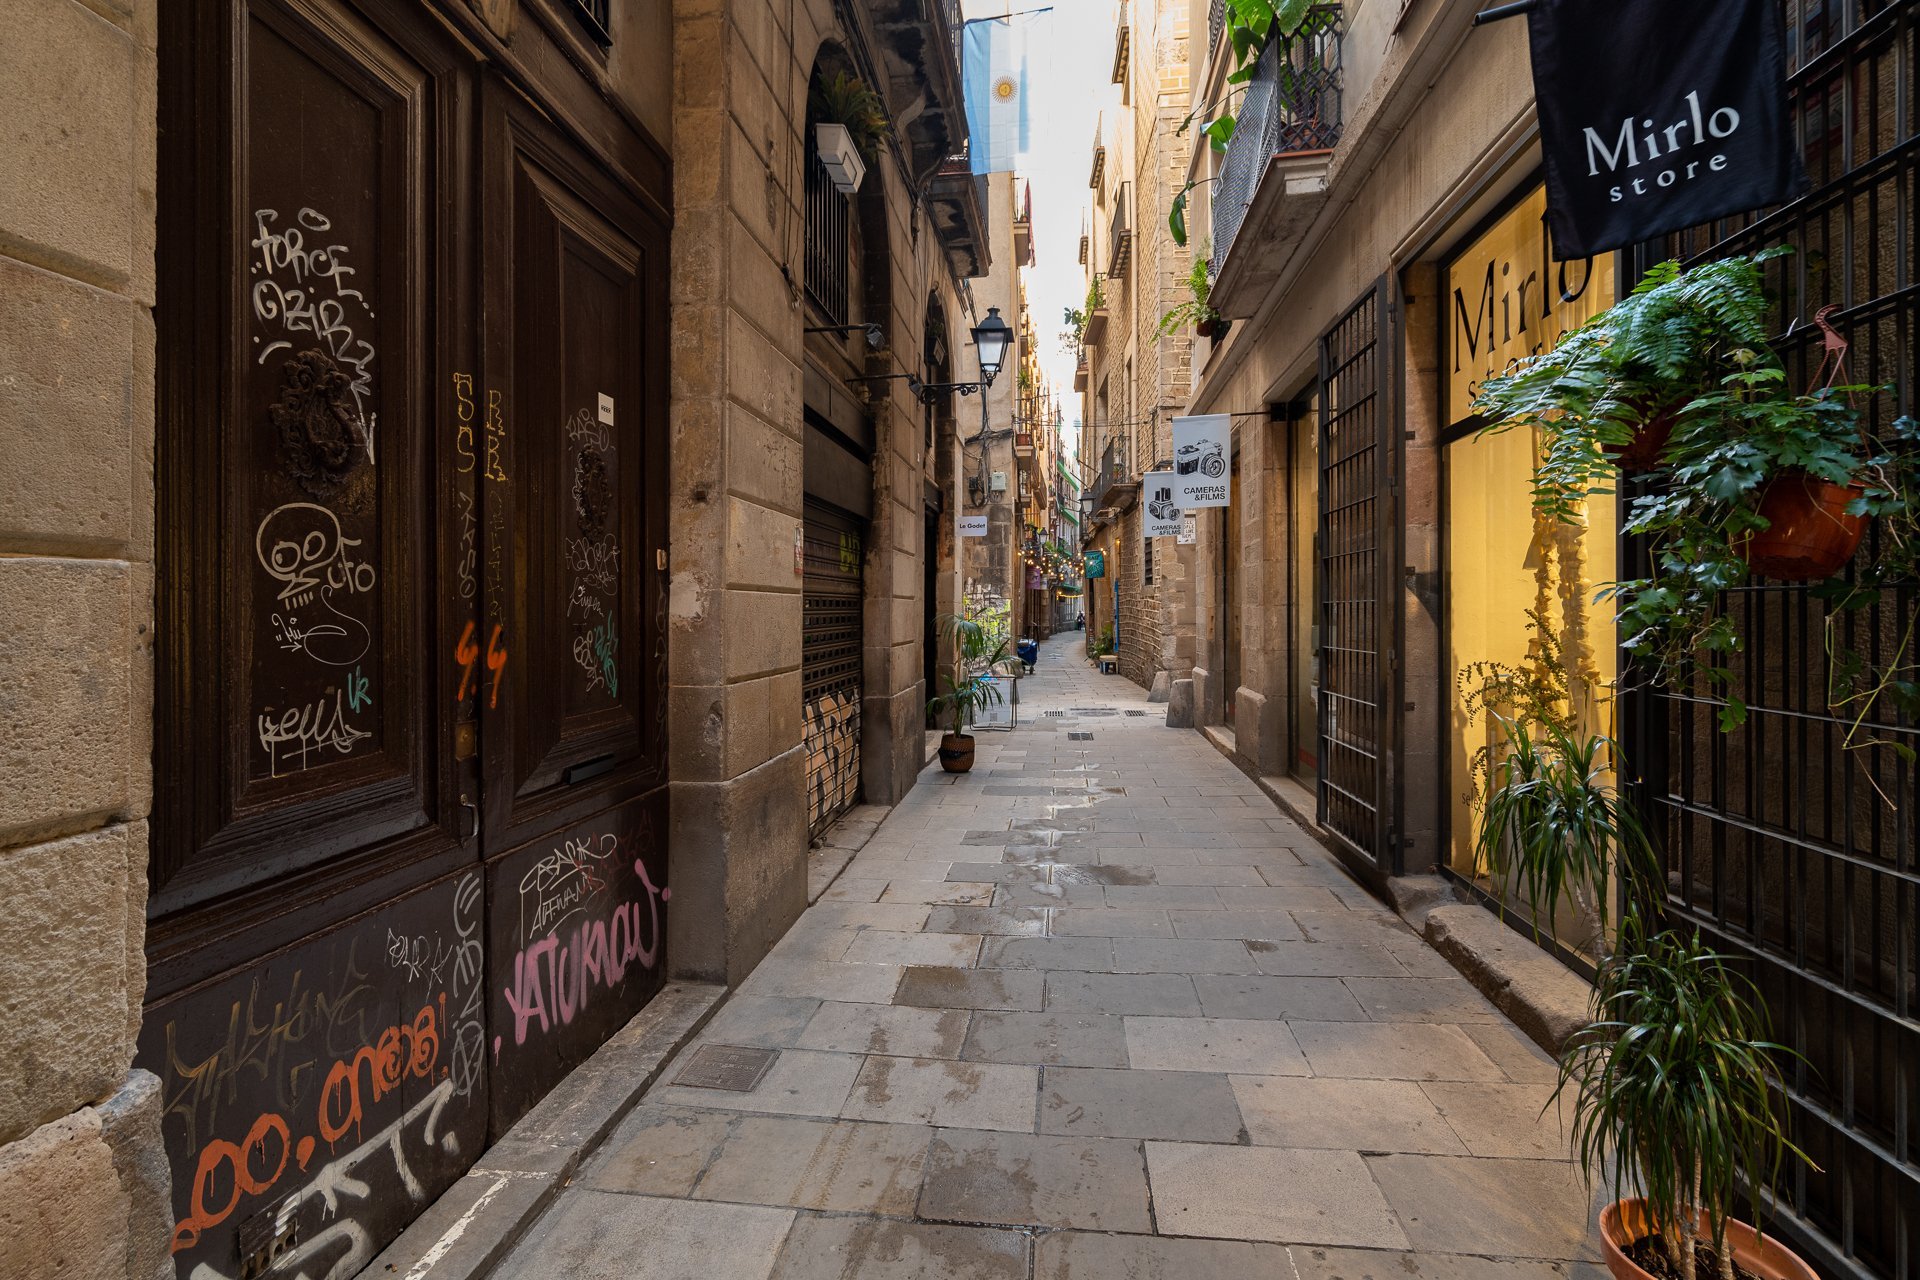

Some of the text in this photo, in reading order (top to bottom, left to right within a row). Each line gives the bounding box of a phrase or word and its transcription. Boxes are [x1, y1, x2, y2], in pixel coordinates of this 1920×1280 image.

[1583, 90, 1740, 176] Mirlo
[1609, 151, 1728, 202] store
[1454, 207, 1594, 374] Mirlo
[1184, 486, 1226, 495] CAMERAS
[1194, 493, 1226, 501] &FILMS
